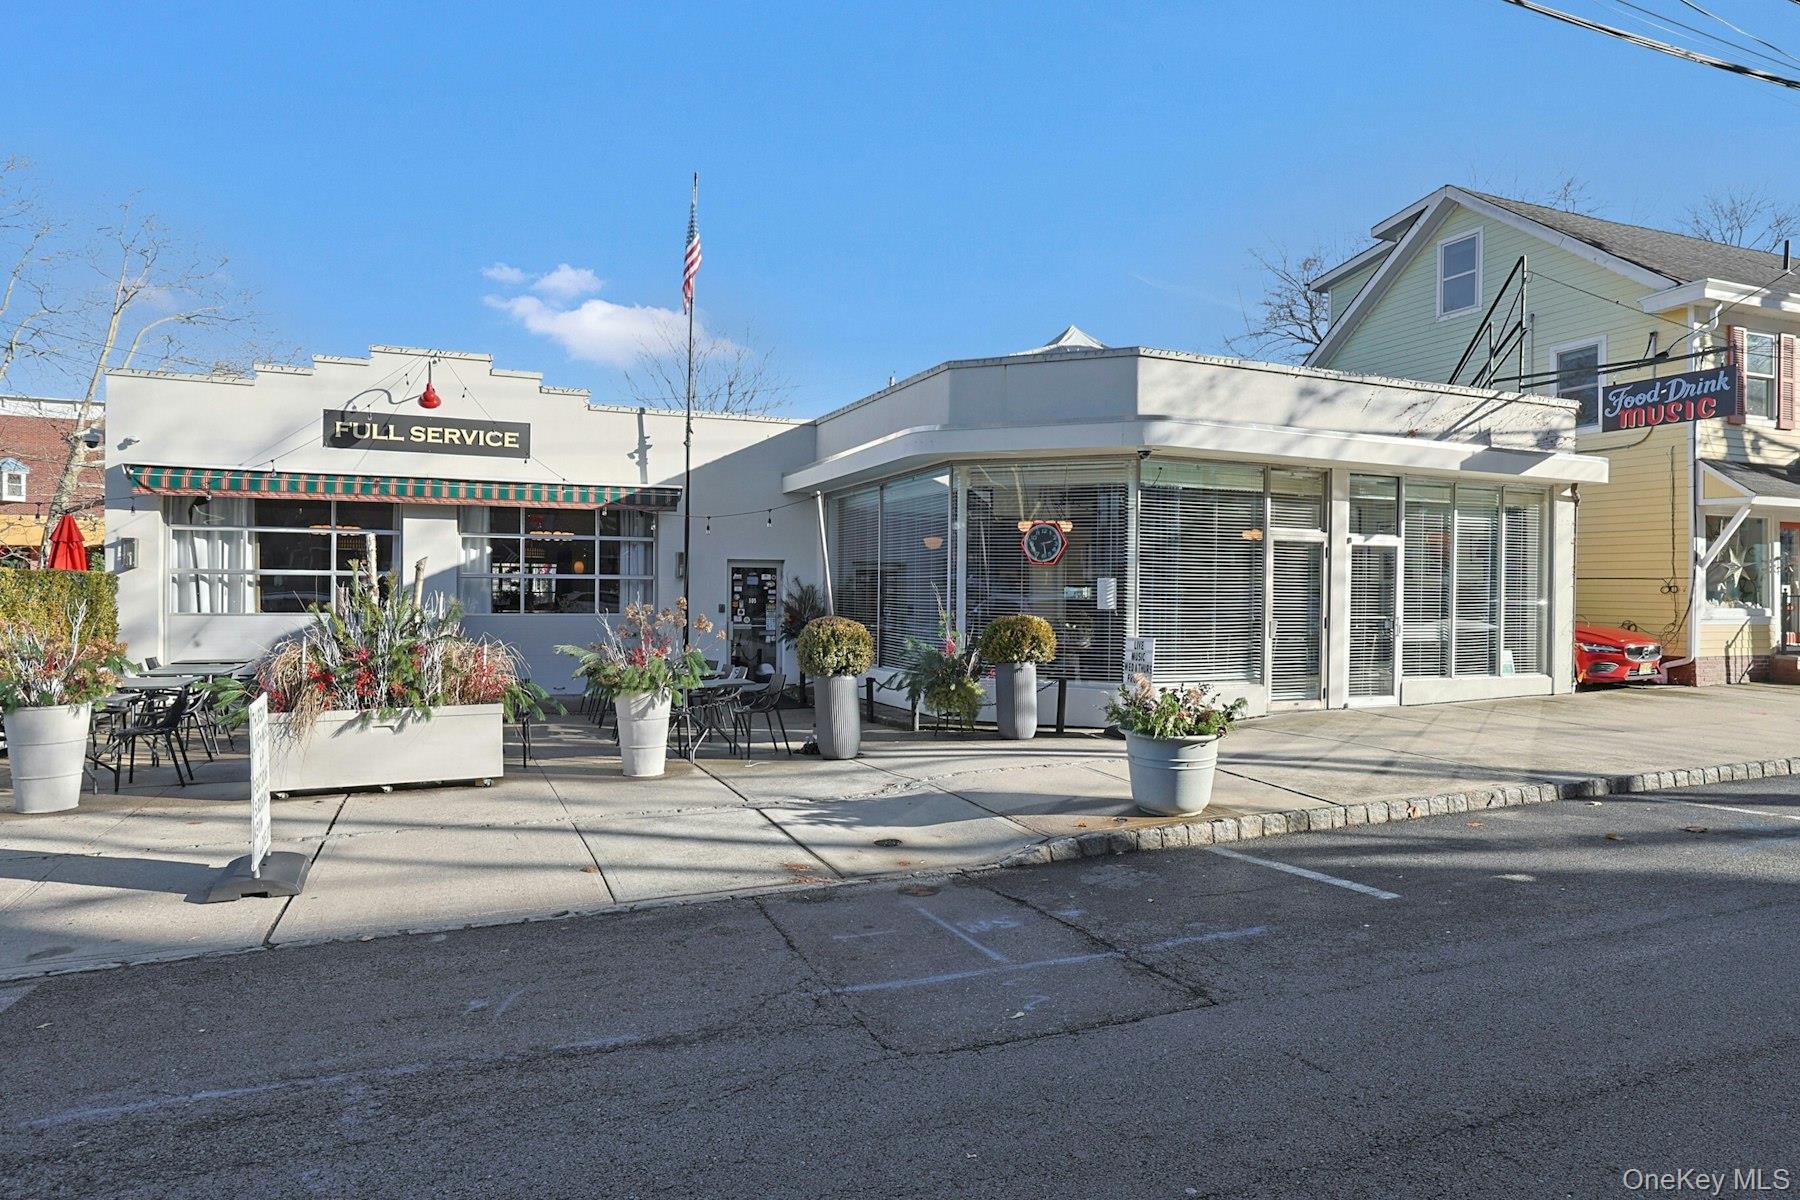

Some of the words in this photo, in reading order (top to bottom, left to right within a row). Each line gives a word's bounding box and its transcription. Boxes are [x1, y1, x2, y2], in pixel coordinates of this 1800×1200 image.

[1618, 395, 1717, 429] MUSIC
[334, 421, 404, 442] FULL
[409, 426, 520, 448] SERVICE
[1134, 640, 1144, 650] LIVE
[1131, 652, 1146, 662] MUSIC
